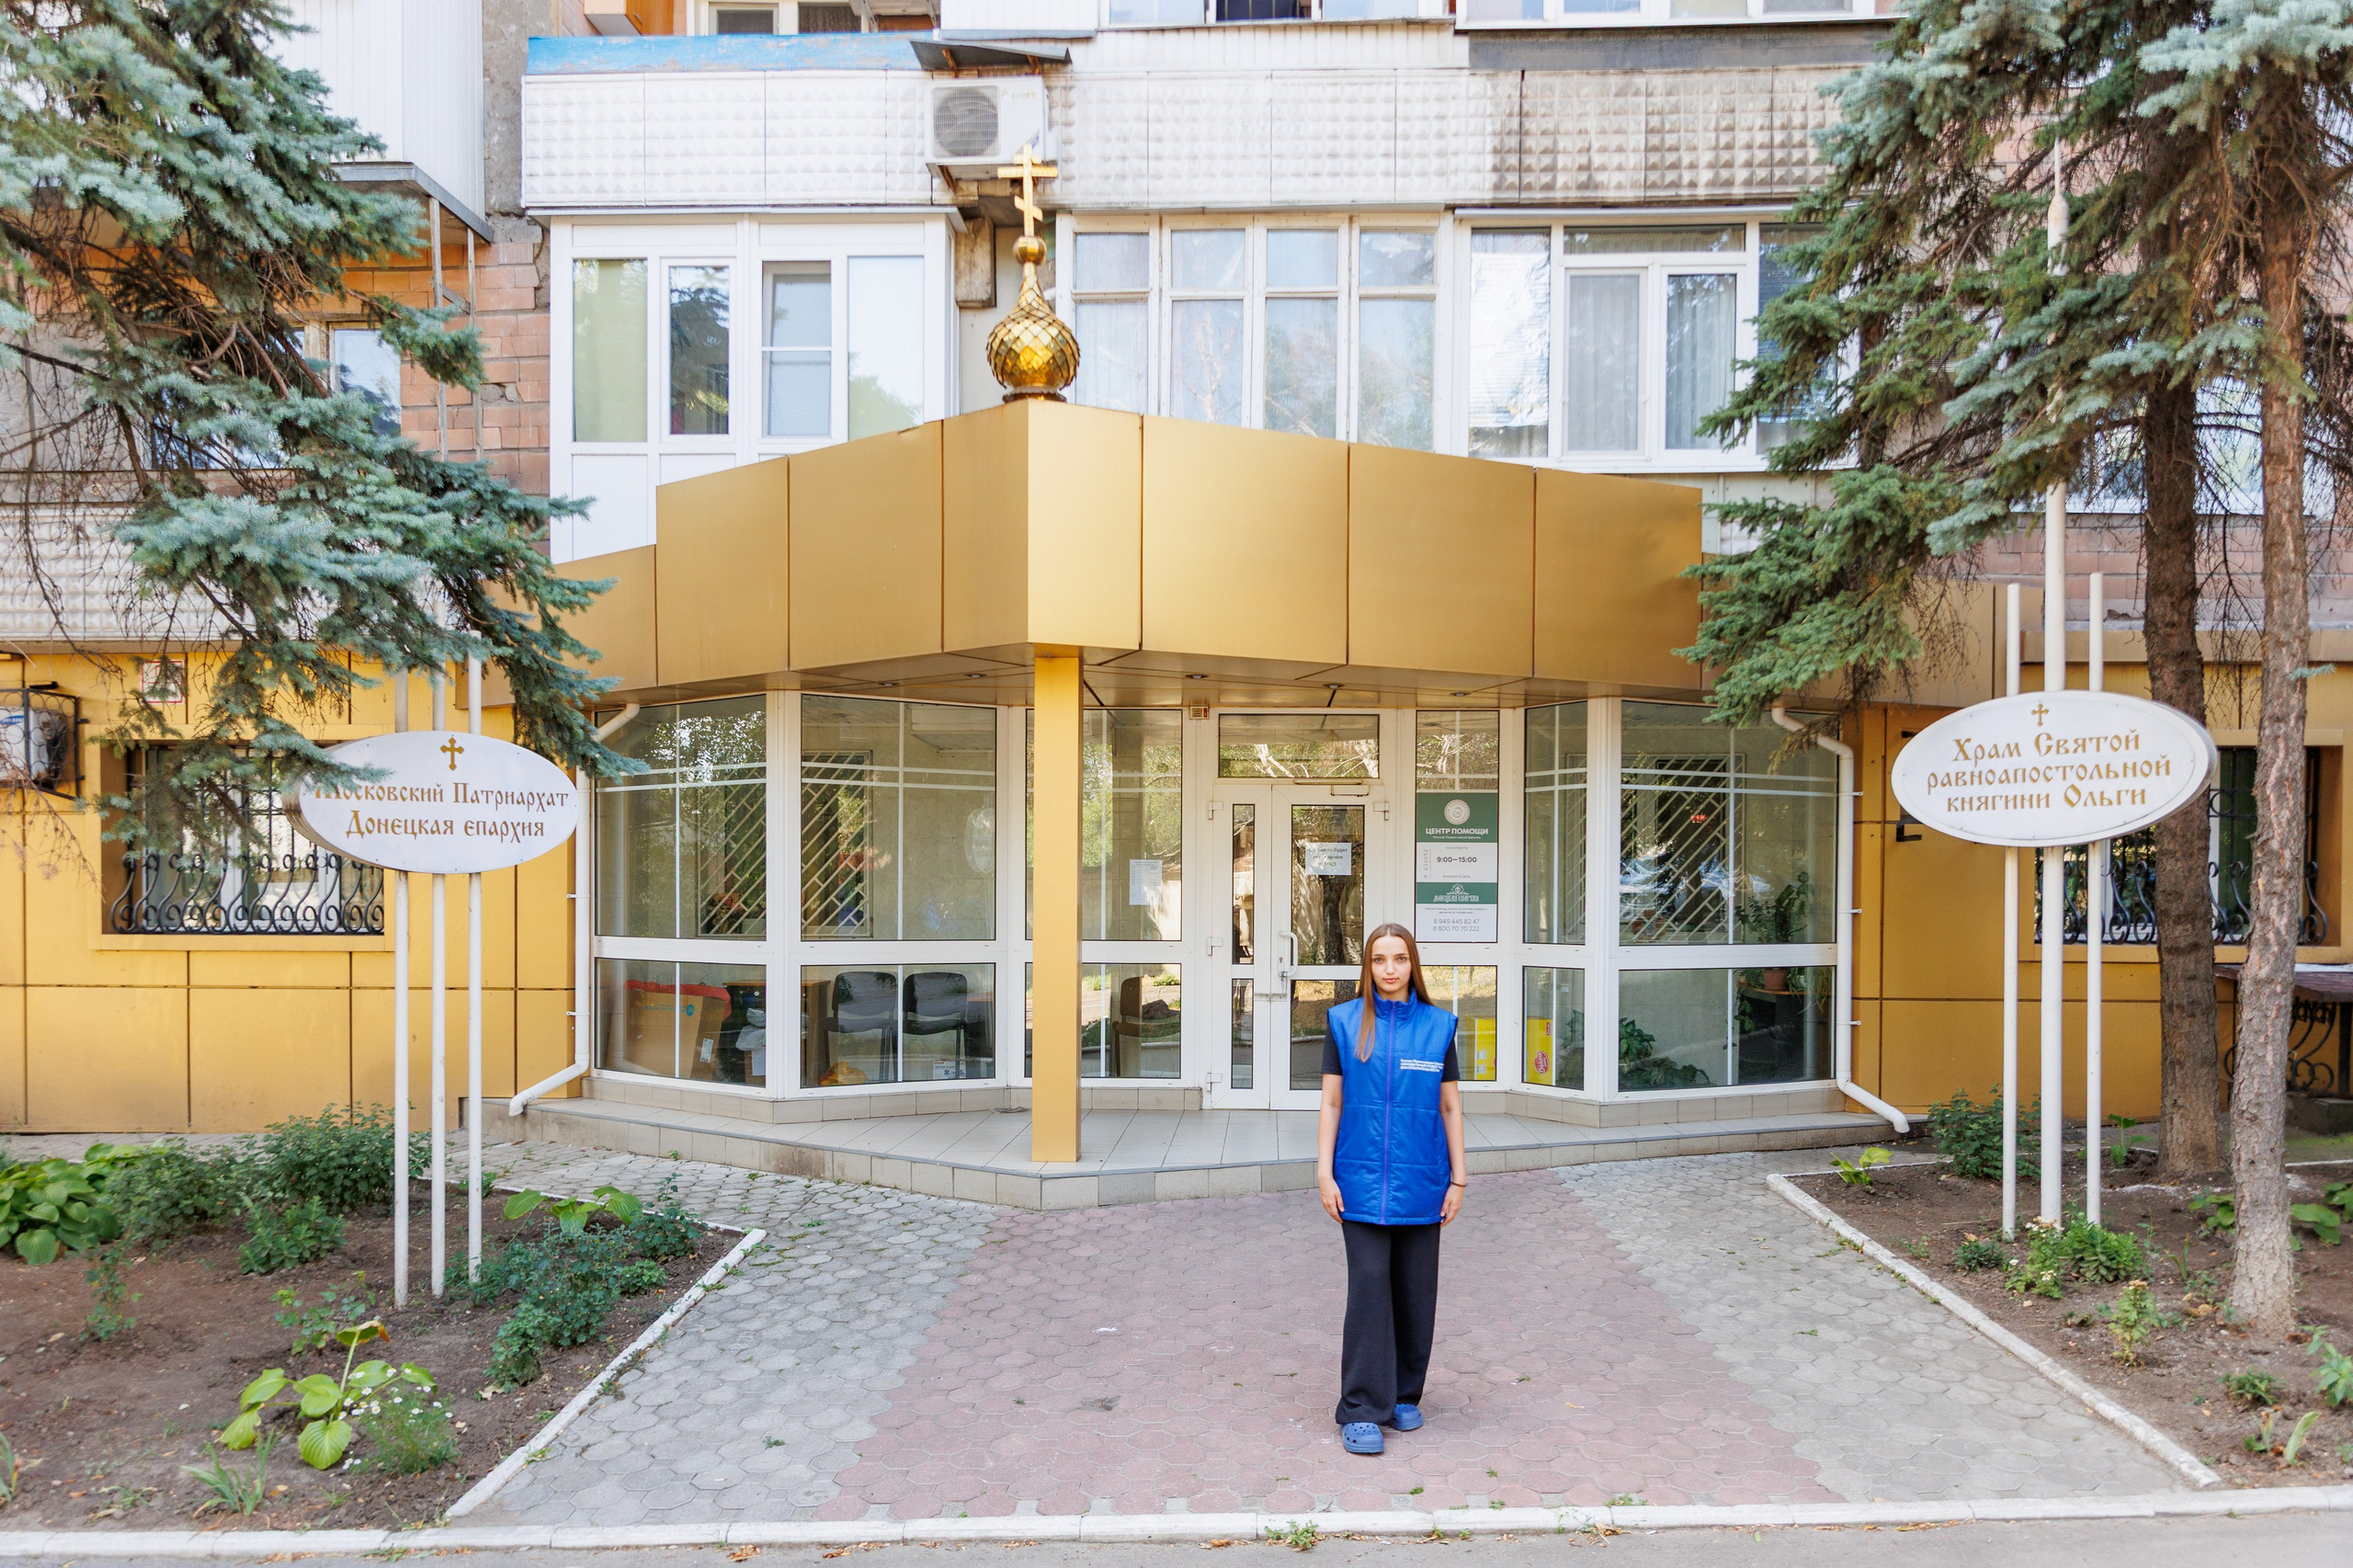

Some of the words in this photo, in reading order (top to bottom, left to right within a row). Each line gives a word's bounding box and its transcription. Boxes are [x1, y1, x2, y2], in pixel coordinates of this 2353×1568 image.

[1952, 738, 2022, 767] Храм
[2034, 728, 2141, 757] Святой
[1927, 754, 2171, 795] равноапостольной
[453, 782, 569, 812] Патриархат
[1947, 791, 2050, 812] княгини
[2063, 783, 2146, 809] Ольги
[347, 810, 455, 840] Донецкая
[464, 818, 545, 844] епархия
